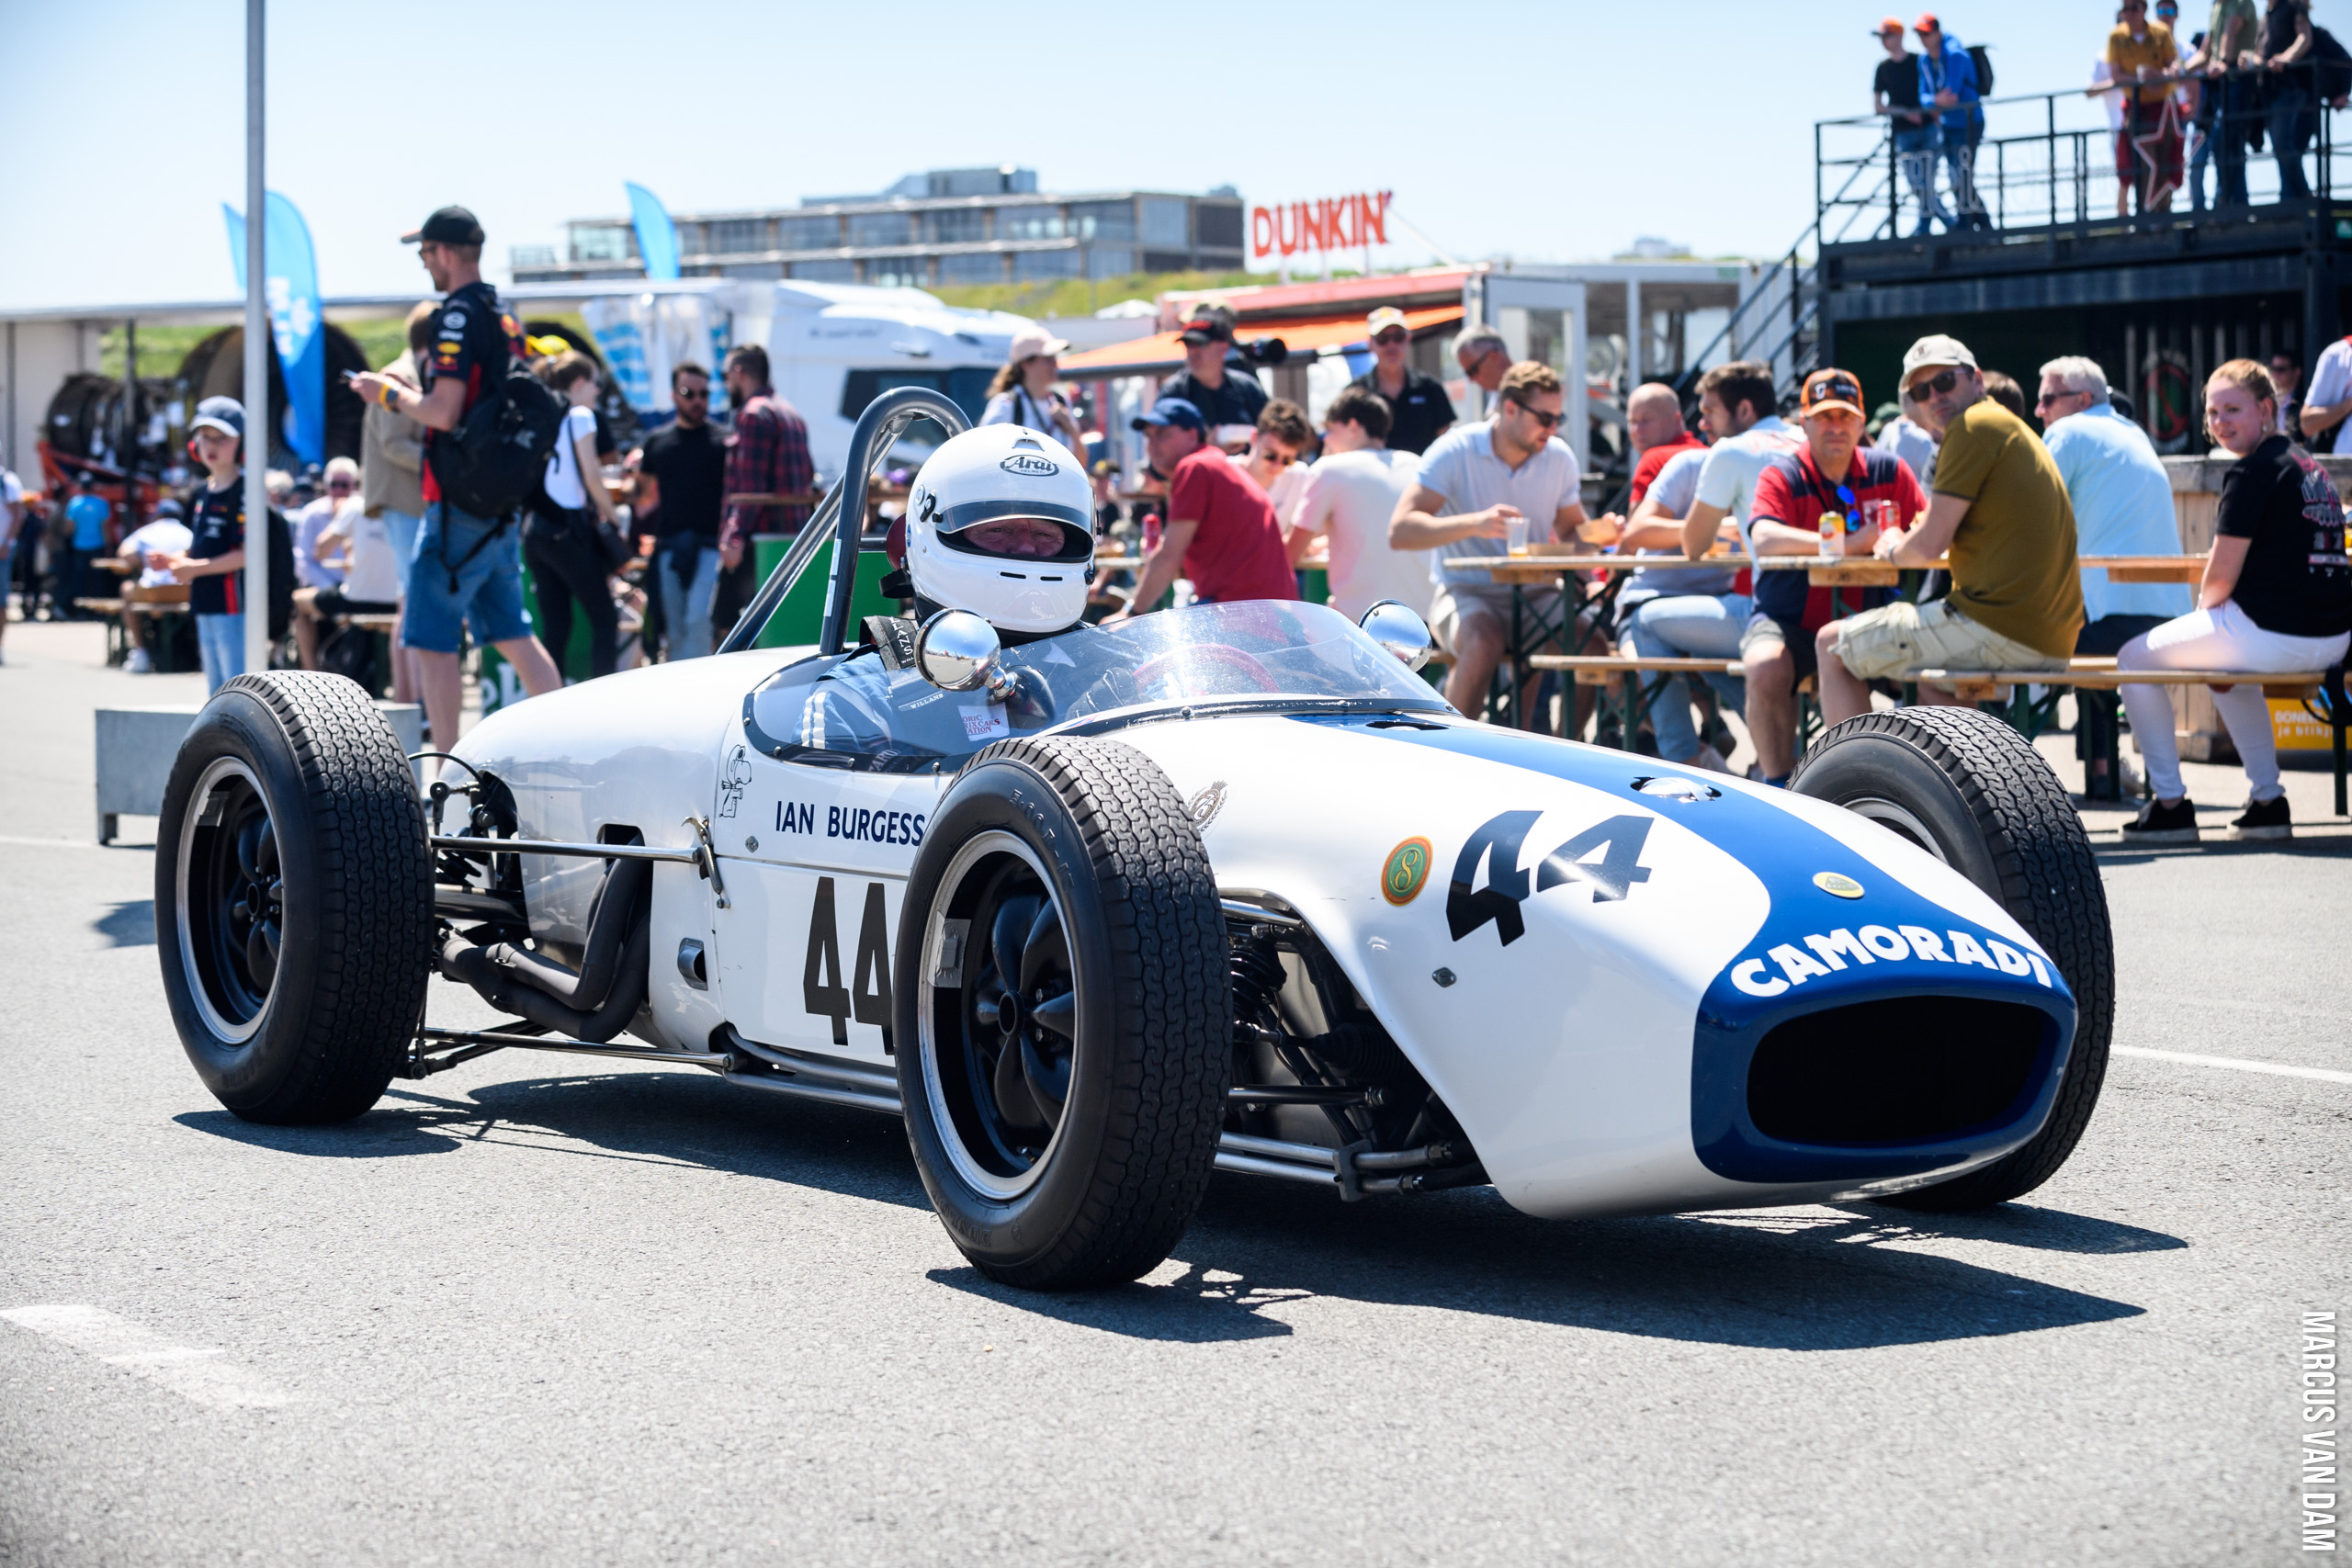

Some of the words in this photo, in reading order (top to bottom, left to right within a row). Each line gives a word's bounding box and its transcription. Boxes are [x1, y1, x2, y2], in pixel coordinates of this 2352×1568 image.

[1253, 190, 1392, 258] DUNKIN'
[1005, 457, 1053, 471] Arai
[910, 693, 944, 708] WILLANS
[978, 718, 1000, 727] CARS
[775, 800, 815, 835] IAN
[827, 806, 925, 847] BURGESS
[1446, 810, 1655, 947] 44
[803, 876, 895, 1055] 44
[1730, 924, 2052, 998] CAMORADI
